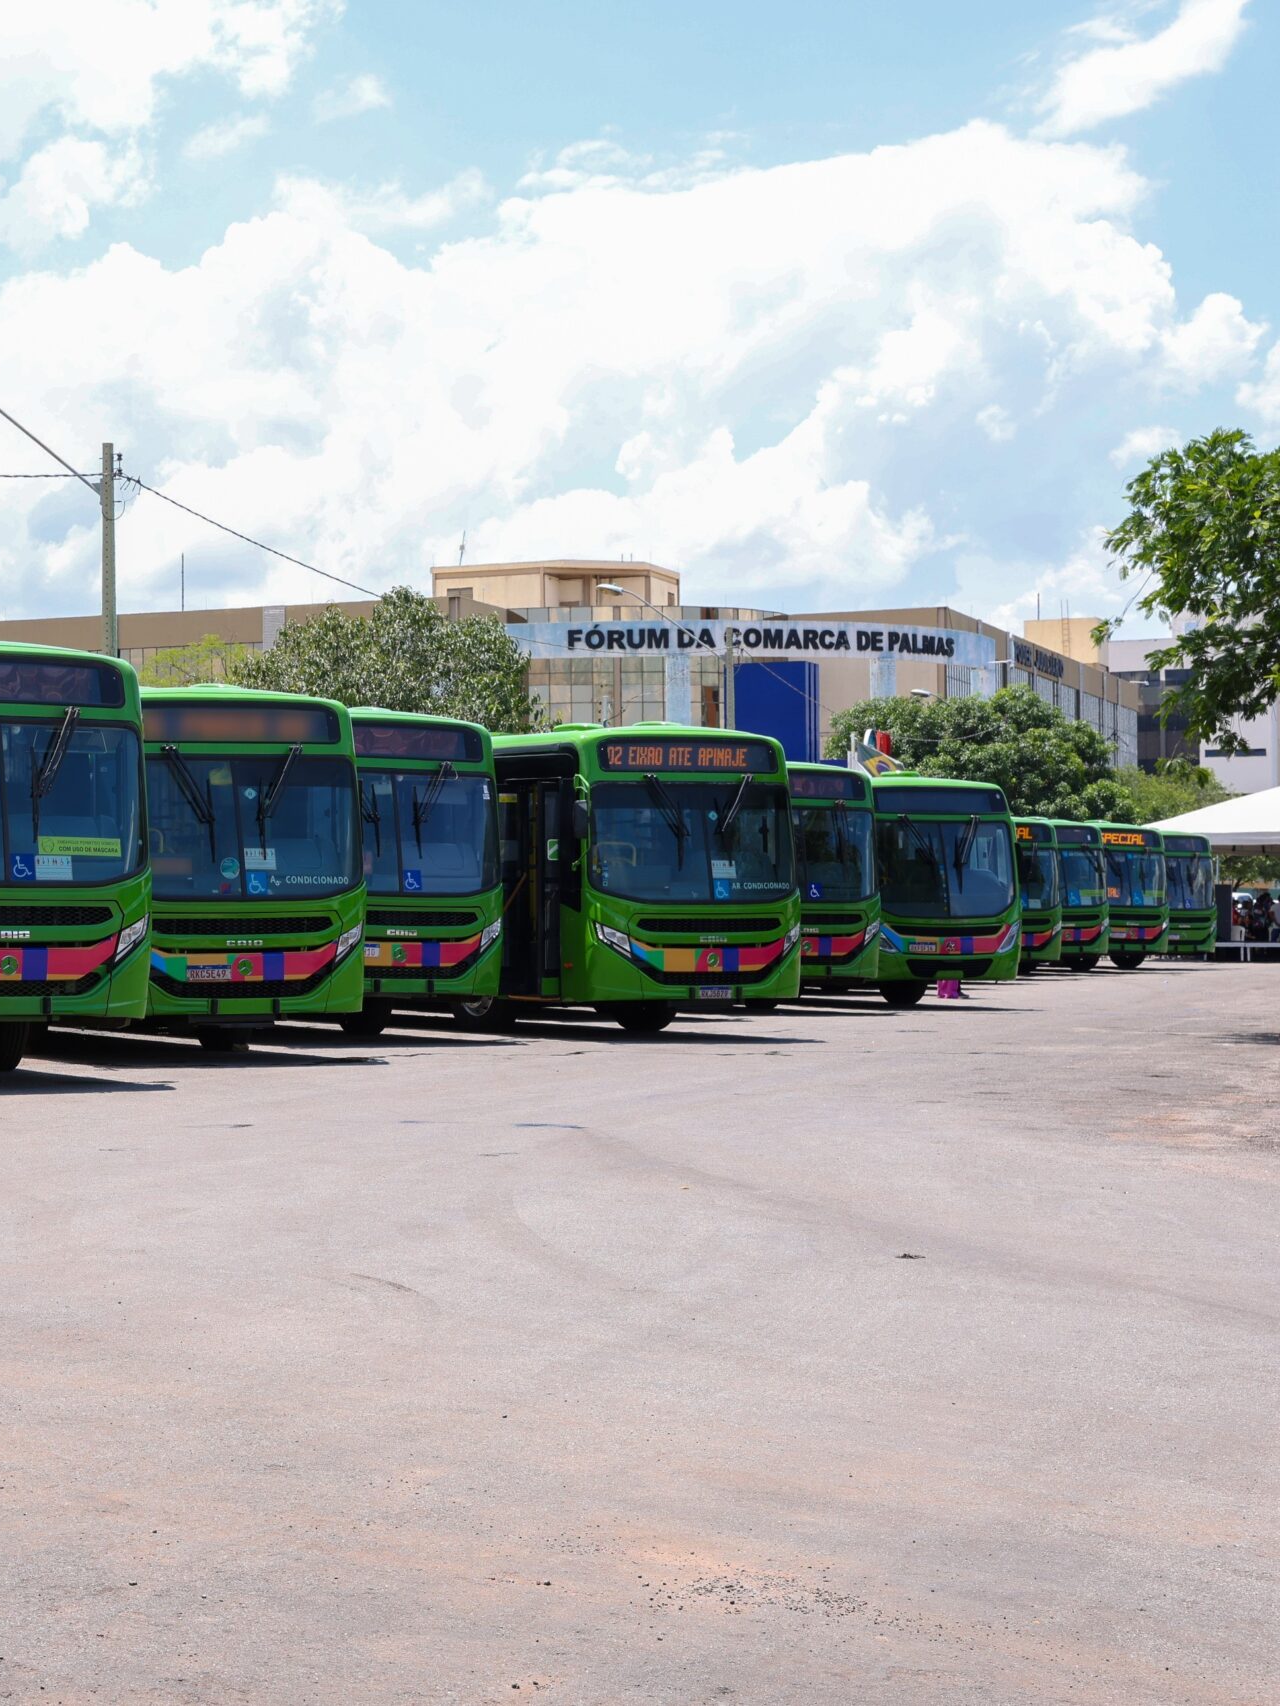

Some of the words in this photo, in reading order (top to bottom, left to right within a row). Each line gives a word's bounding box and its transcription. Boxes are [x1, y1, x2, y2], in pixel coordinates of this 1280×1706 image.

[567, 624, 670, 650] FÓRUM
[677, 628, 716, 649] DA
[724, 627, 851, 650] COMARCA
[856, 630, 884, 652] DE
[887, 631, 956, 658] PALMAS
[627, 746, 664, 766] EIXAO
[668, 747, 693, 766] ATE
[697, 747, 748, 767] APINAJE
[285, 875, 349, 885] CONDICIONADO
[731, 882, 741, 890] AR
[743, 882, 790, 890] CONDICIONADO
